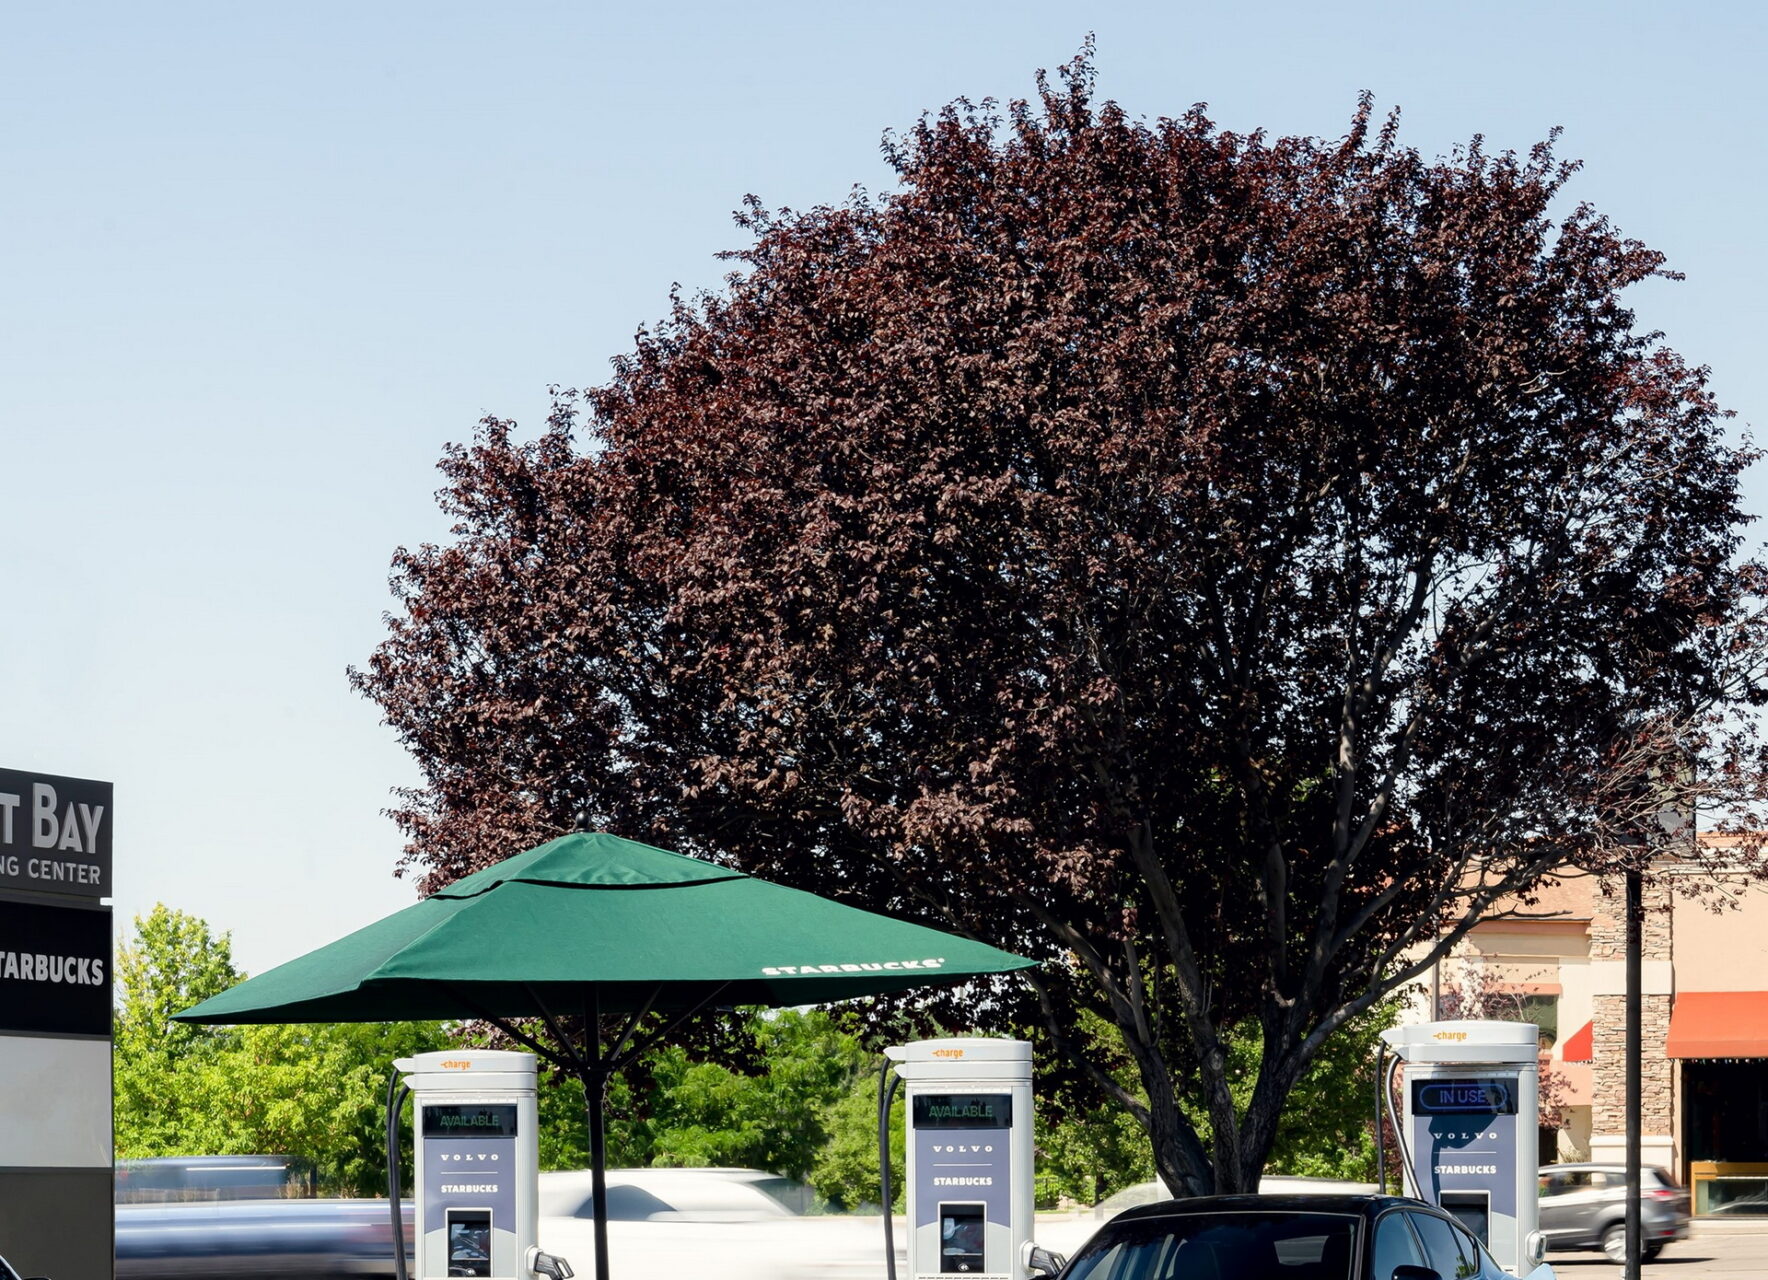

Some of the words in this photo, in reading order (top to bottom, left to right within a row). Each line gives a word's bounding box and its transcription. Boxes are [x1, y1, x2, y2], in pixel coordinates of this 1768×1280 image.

[32, 782, 104, 854] BAY
[28, 858, 101, 884] CENTER
[761, 958, 942, 976] STARBUCKS
[1440, 1090, 1454, 1104] IN
[1458, 1089, 1486, 1104] USE
[929, 1105, 993, 1118] AVAILABLE
[440, 1115, 499, 1127] AVAILABLE
[1434, 1132, 1497, 1140] VOLVO
[933, 1145, 993, 1153] VOLVO
[440, 1153, 499, 1161] VOLVO
[1434, 1165, 1497, 1175] STARBUCKS
[933, 1177, 993, 1186] STARBUCKS
[441, 1184, 498, 1194] STARBUCKS
